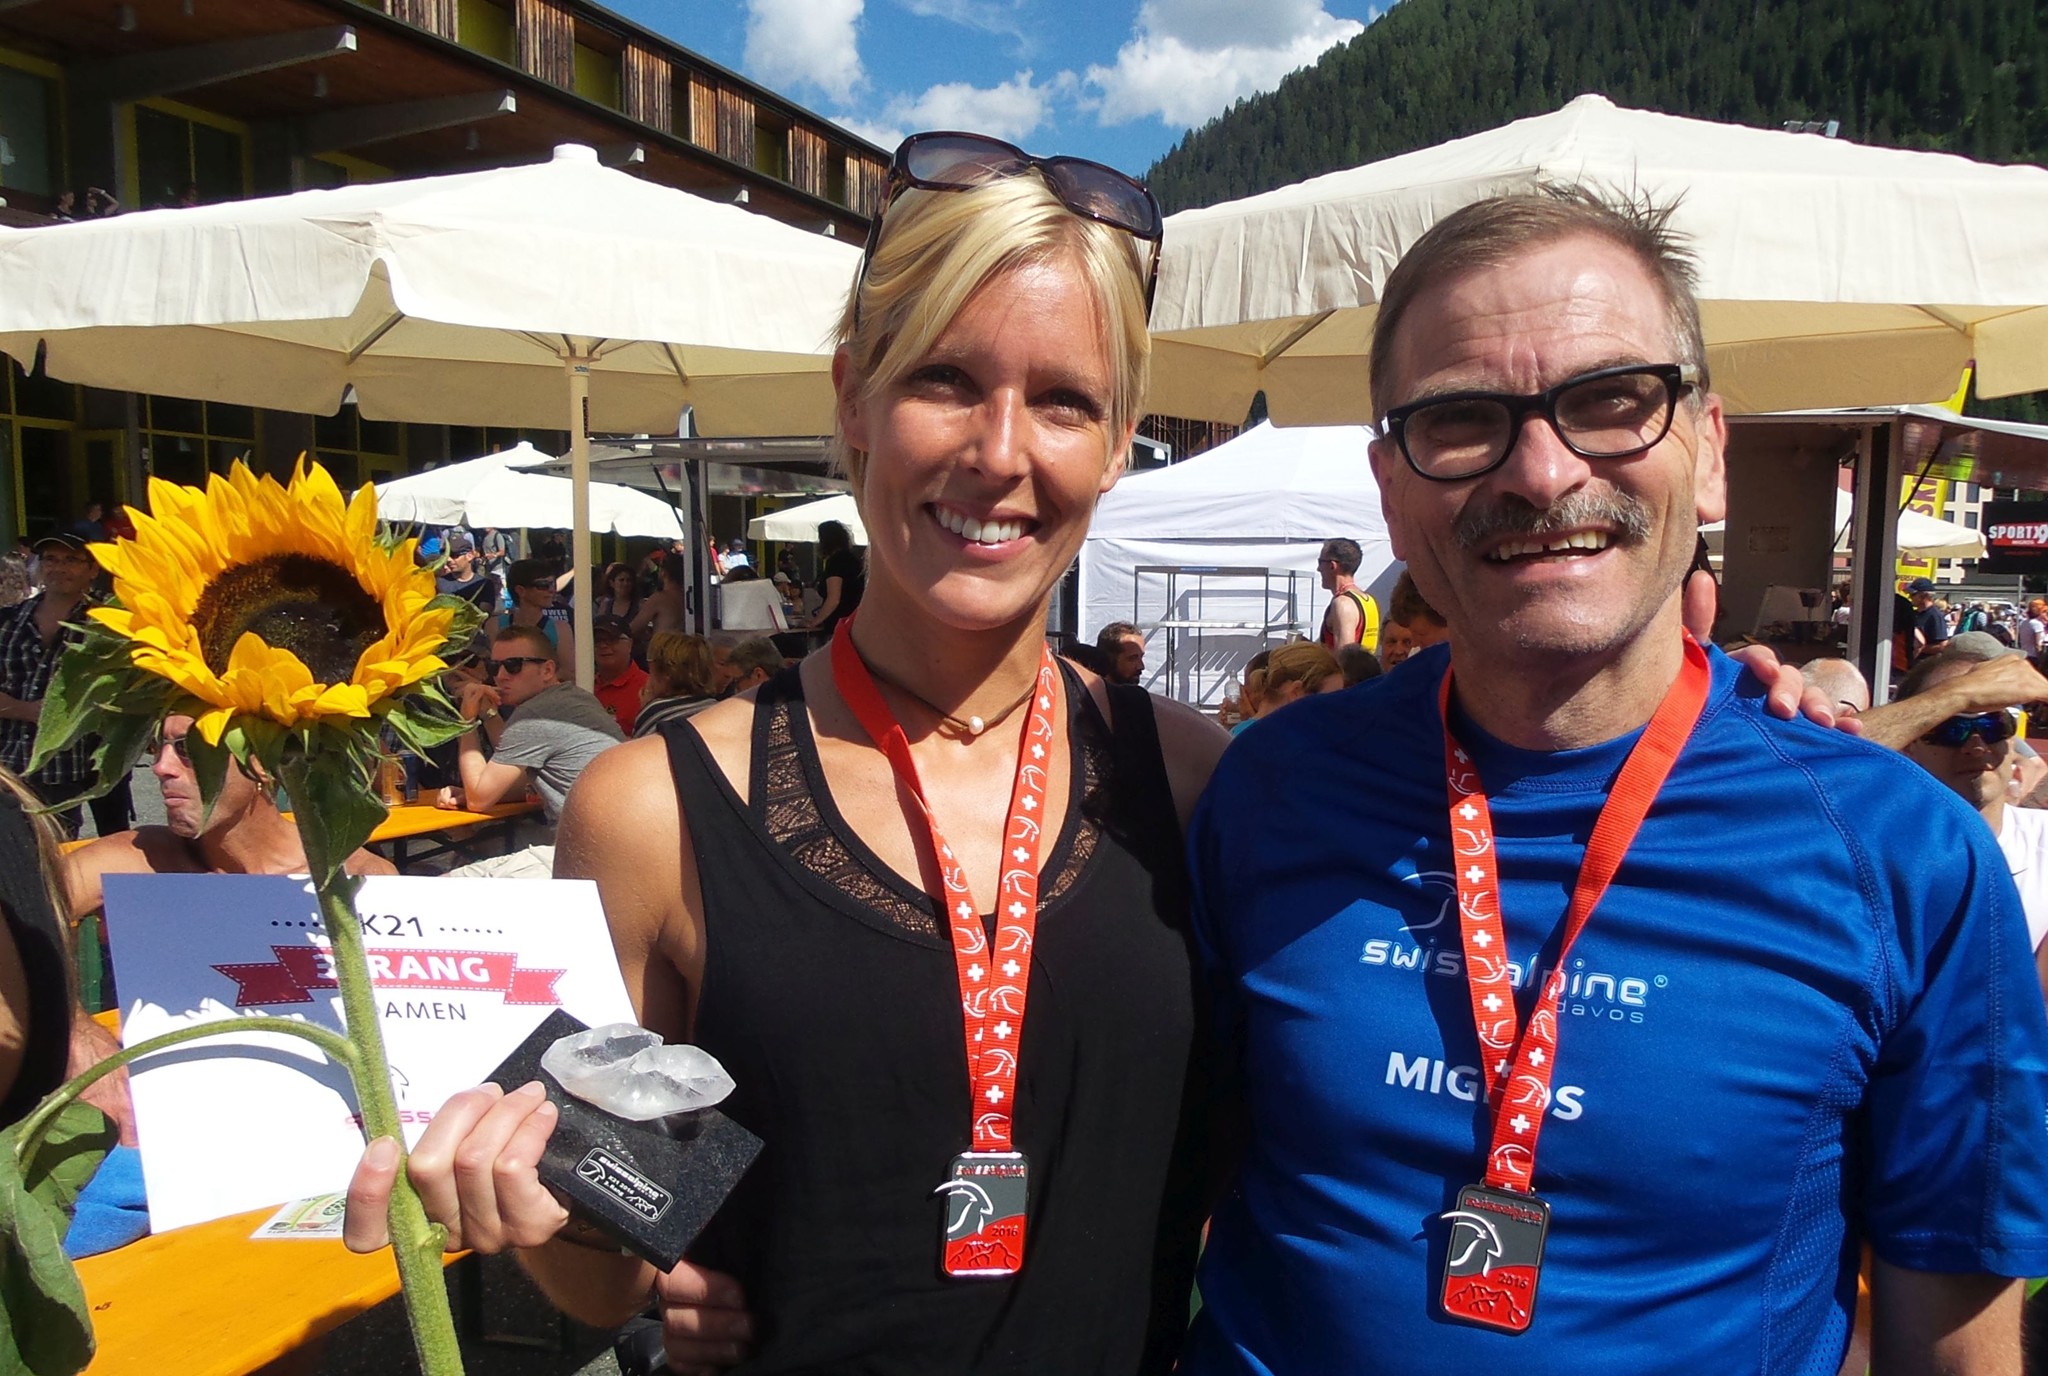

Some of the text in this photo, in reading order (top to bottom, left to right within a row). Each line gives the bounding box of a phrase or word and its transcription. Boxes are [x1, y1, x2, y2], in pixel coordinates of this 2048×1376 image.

[361, 913, 423, 937] K21
[374, 954, 491, 983] RANG
[379, 1001, 467, 1021] AMEN
[1556, 1001, 1644, 1024] davos
[1385, 1051, 1586, 1121] MIGS
[991, 1224, 1019, 1237] 2016
[1499, 1273, 1529, 1290] 2016
